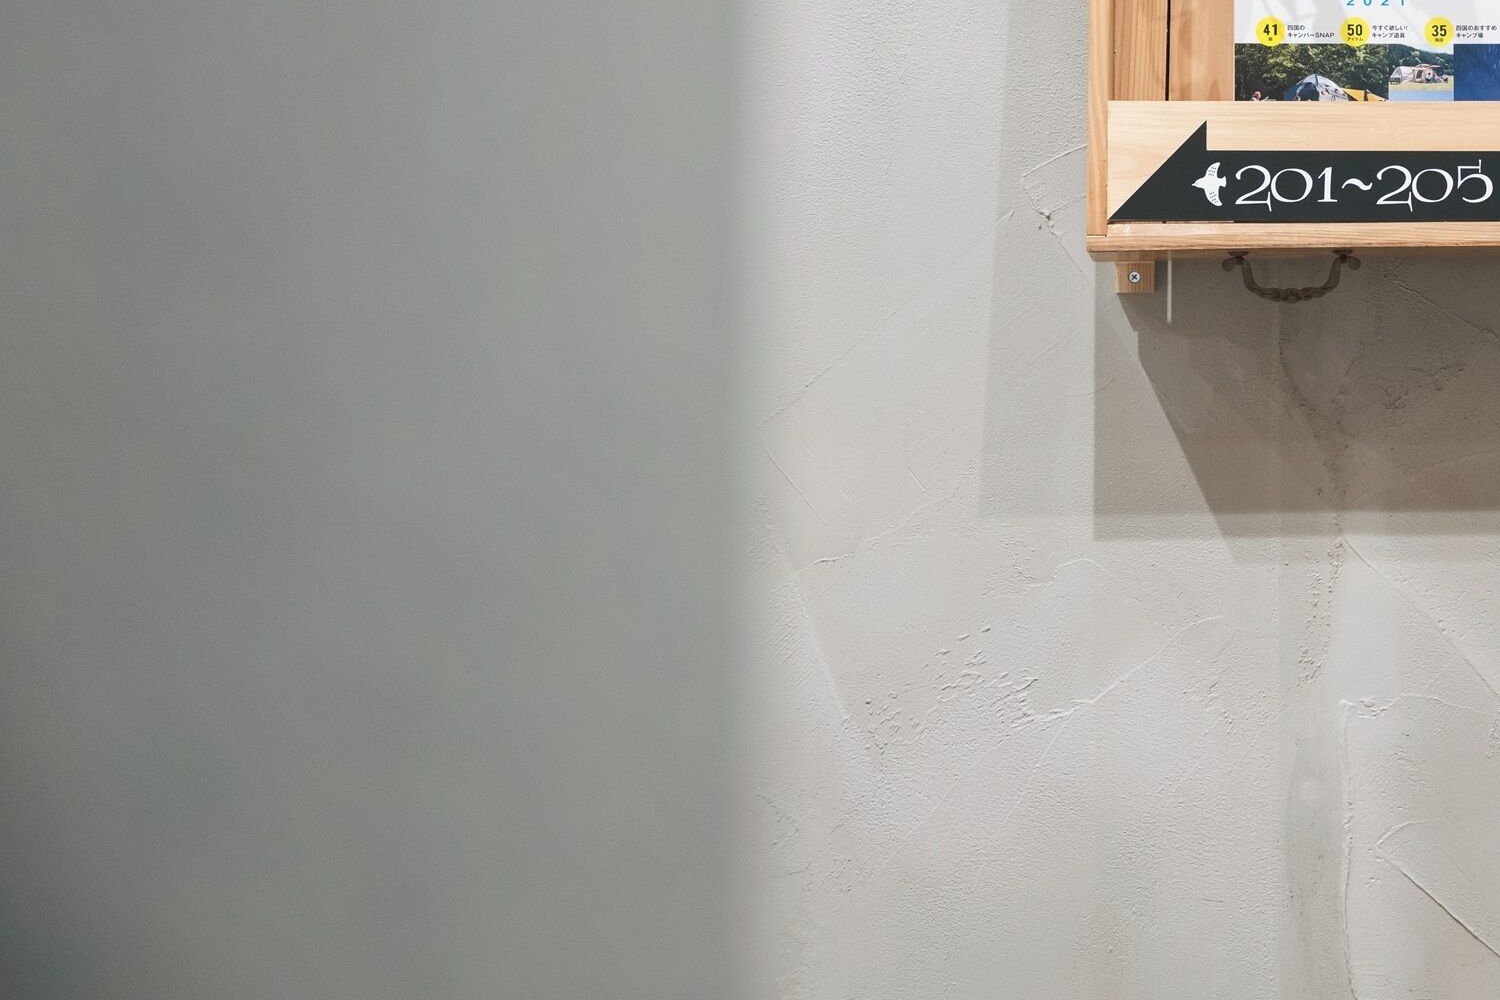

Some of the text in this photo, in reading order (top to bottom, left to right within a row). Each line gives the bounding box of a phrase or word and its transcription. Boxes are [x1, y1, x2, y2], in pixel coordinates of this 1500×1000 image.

[1263, 24, 1278, 36] 41
[1347, 25, 1363, 36] 50
[1432, 25, 1447, 37] 35
[1235, 159, 1494, 213] 201~205
